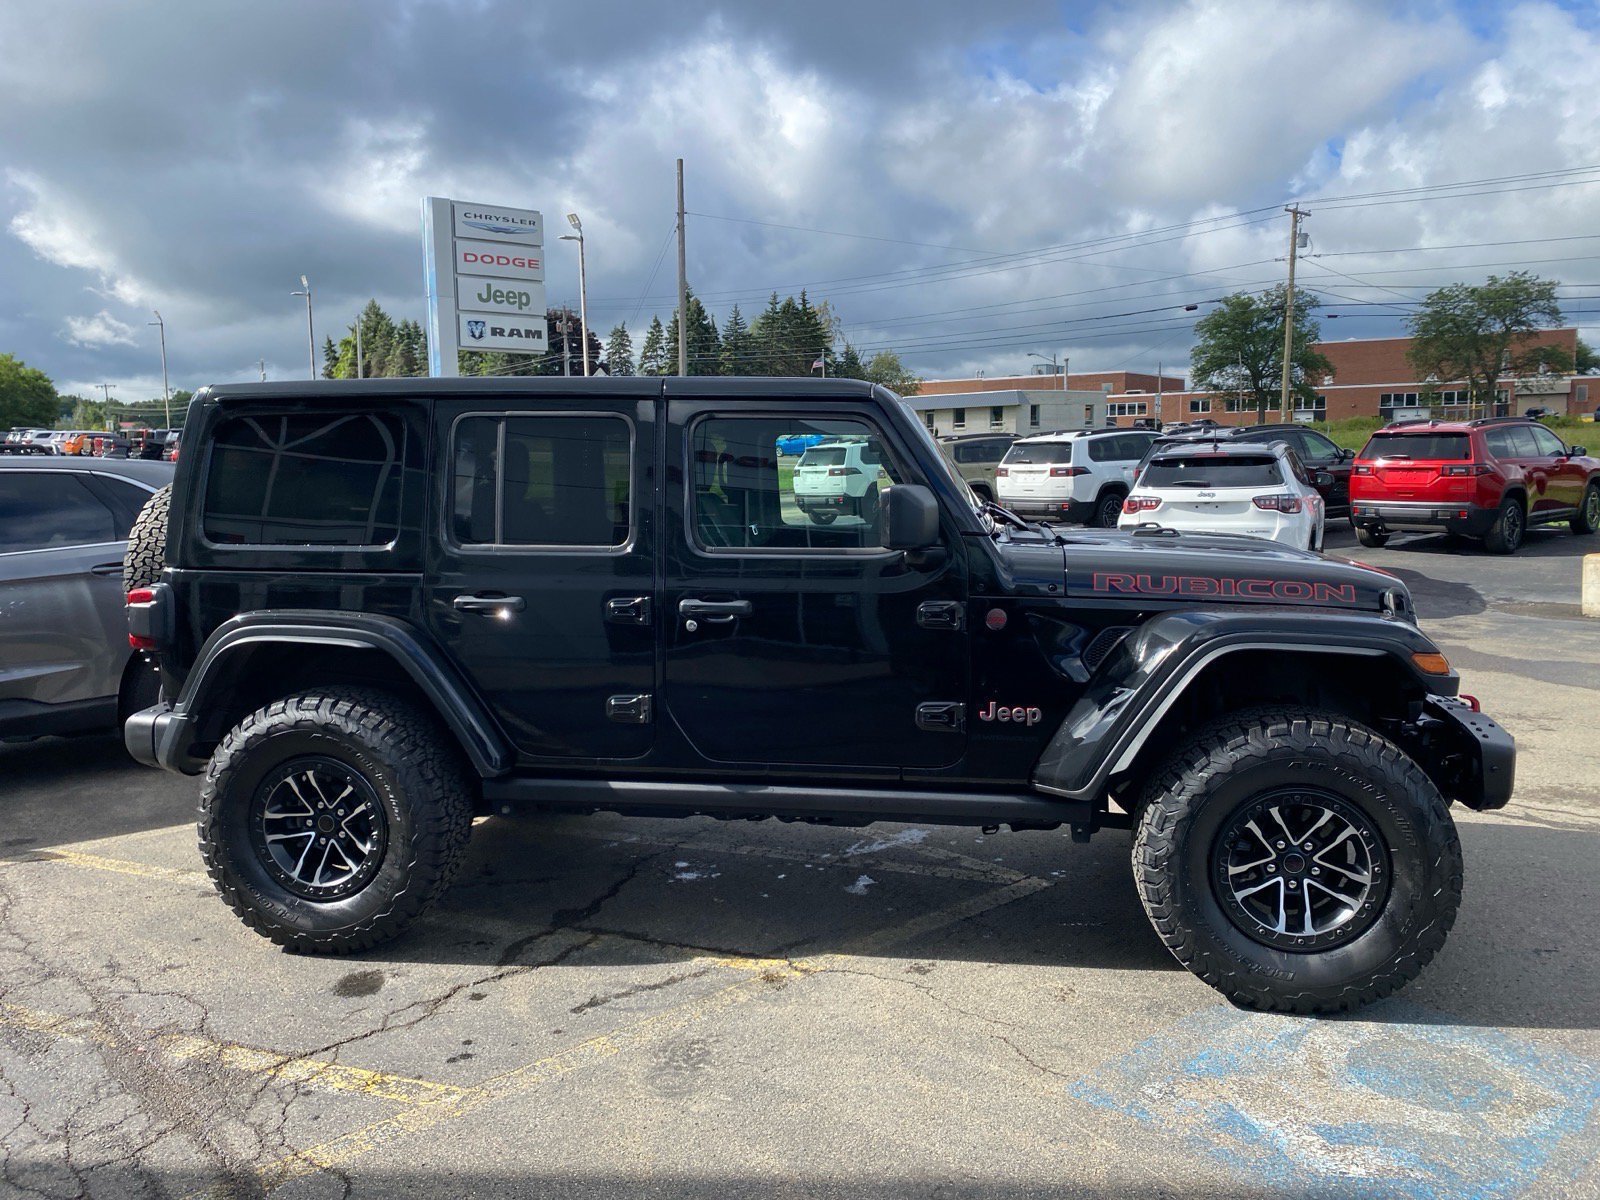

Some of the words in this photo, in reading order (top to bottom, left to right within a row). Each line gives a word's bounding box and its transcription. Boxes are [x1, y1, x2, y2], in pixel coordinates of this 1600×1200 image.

[463, 212, 537, 227] CHRYSLER
[463, 252, 540, 269] DODGE
[477, 283, 531, 310] Jeep
[490, 326, 543, 340] RAM
[1093, 572, 1356, 603] RUBICON
[979, 701, 1042, 727] Jeep
